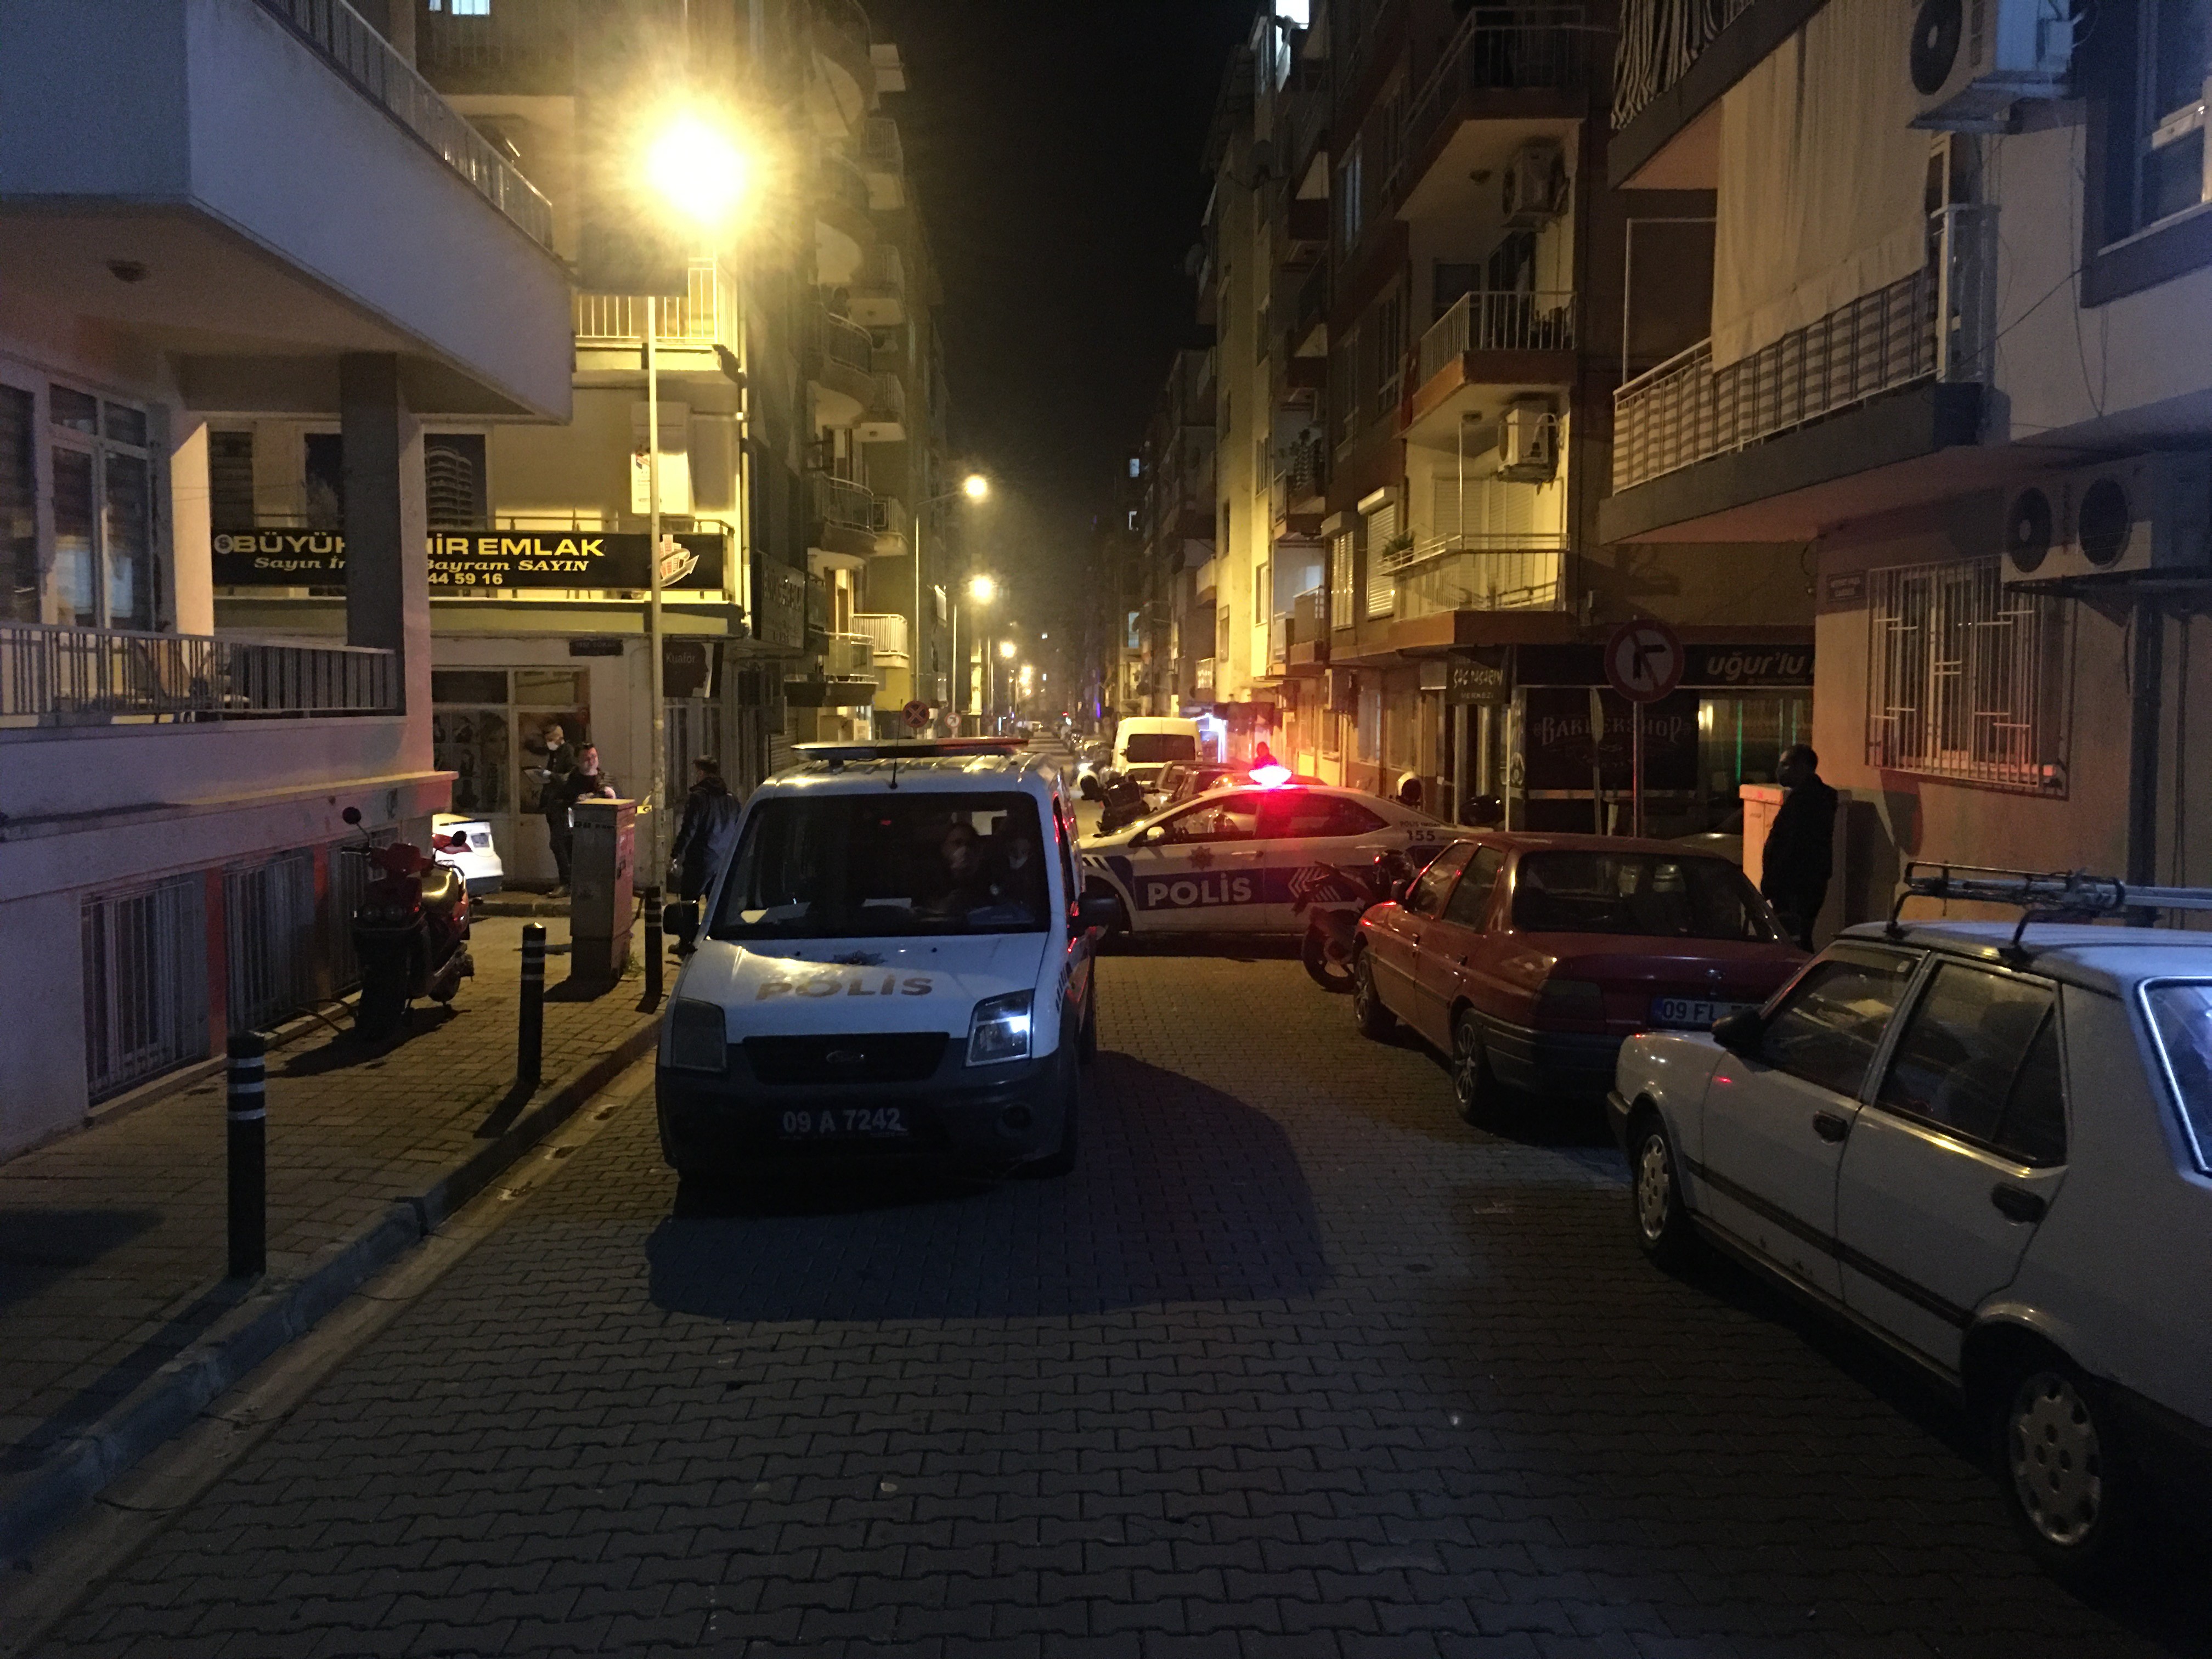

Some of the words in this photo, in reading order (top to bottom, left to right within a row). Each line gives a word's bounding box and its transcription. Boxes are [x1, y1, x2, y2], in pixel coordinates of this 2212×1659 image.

[478, 538, 605, 556] EMLAK
[254, 557, 322, 571] Sayın
[518, 560, 589, 571] SAYIN
[454, 573, 476, 585] 59
[482, 573, 503, 585] 16
[1407, 830, 1435, 842] 155
[1148, 873, 1251, 906] POLİS
[1664, 1001, 1687, 1019] 09
[1694, 1004, 1717, 1021] FL
[783, 1111, 811, 1133] 09
[819, 1110, 836, 1133] A
[842, 1108, 908, 1131] 7242
